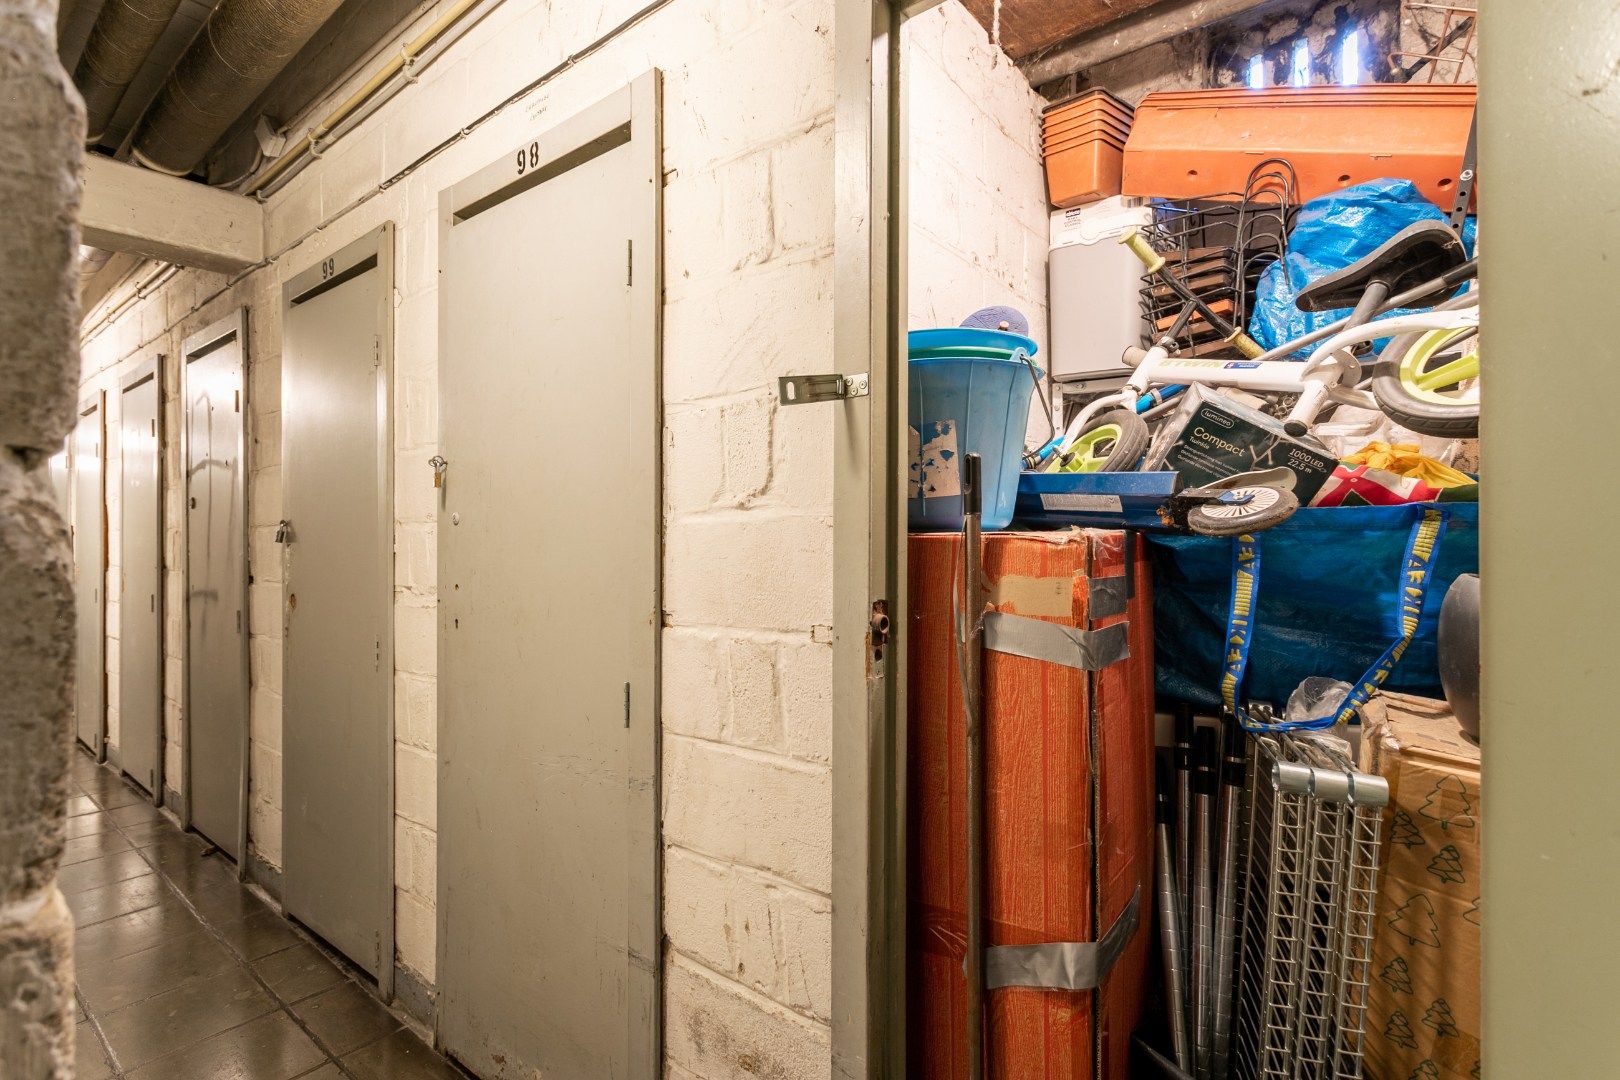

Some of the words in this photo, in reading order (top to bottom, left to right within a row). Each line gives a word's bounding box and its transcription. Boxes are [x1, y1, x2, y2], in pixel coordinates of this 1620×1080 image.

[516, 141, 539, 175] 98
[322, 257, 335, 280] 99
[1204, 410, 1232, 427] lumineo
[1193, 426, 1247, 457] Compact
[1287, 458, 1307, 471] 22.5
[1304, 466, 1313, 474] m
[1288, 448, 1312, 463] 1000
[1309, 458, 1325, 469] LED
